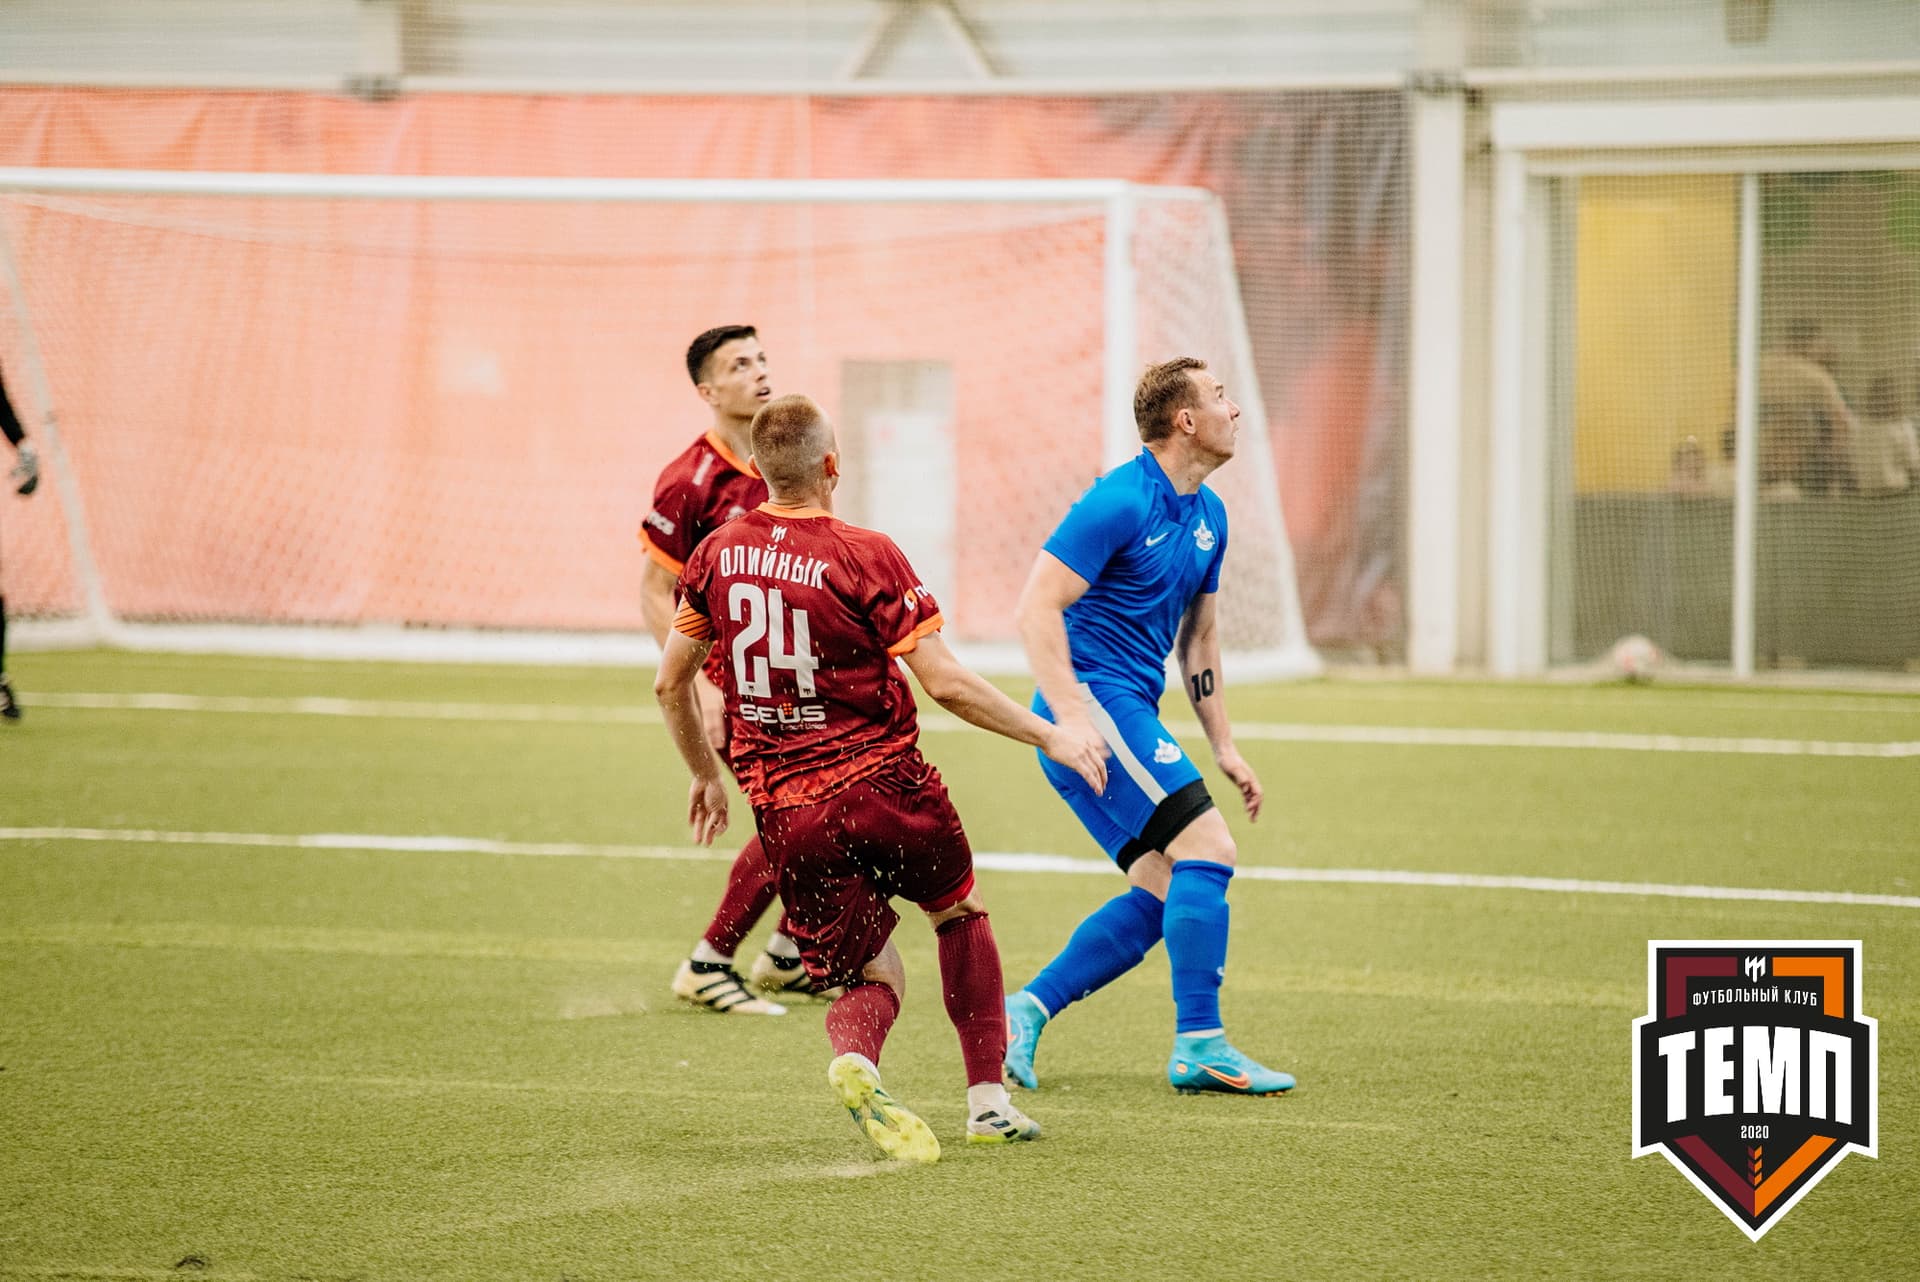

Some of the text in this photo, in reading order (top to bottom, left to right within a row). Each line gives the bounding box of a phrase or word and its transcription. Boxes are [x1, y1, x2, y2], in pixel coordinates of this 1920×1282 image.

[720, 544, 829, 590] ОЛИЙНЫК
[728, 582, 819, 699] 24
[1191, 668, 1214, 703] 10
[739, 703, 826, 723] SEUS
